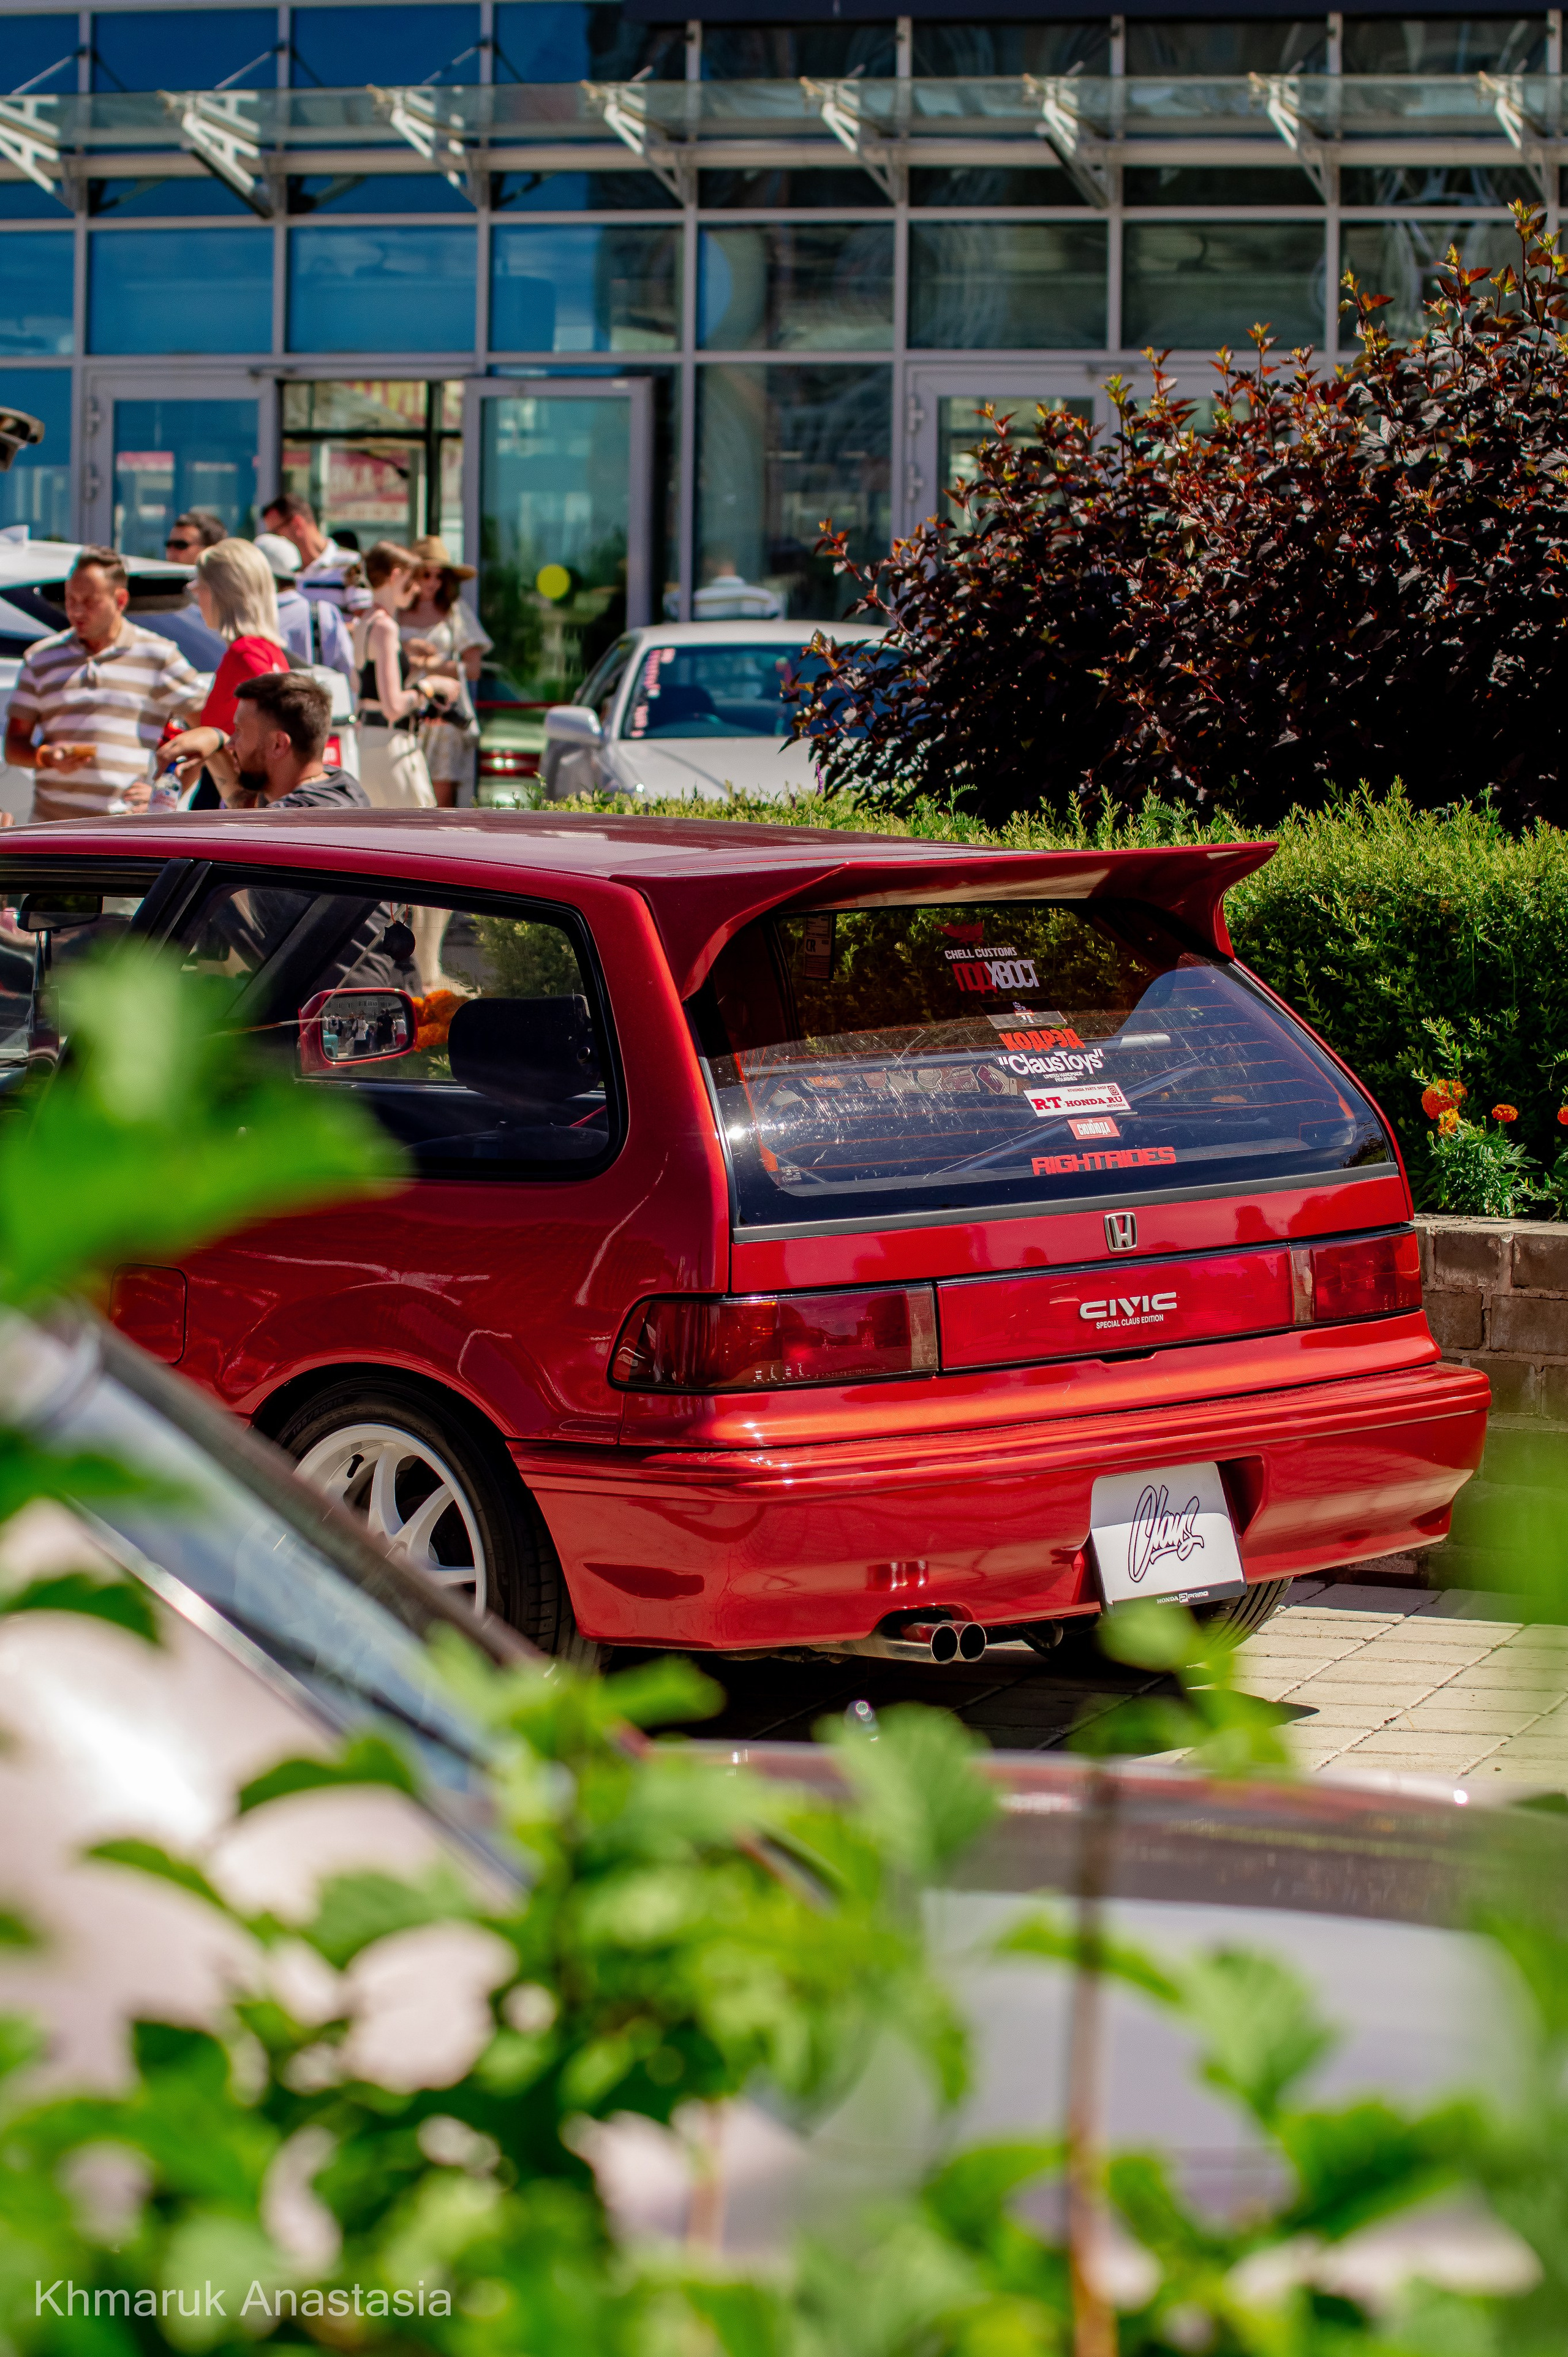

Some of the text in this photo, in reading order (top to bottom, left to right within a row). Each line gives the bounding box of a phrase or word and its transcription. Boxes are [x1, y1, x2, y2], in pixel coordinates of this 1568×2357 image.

[944, 947, 1017, 959] CHELL CUSTOMS
[998, 1028, 1086, 1052] КОДРЭД
[998, 1048, 1103, 1074] "ClausToys"
[1031, 1147, 1176, 1175] RIGHTRIDES
[1079, 1292, 1178, 1320] CIVIC
[1096, 1314, 1164, 1330] SPECIAL CLAUS EDITION
[1188, 1591, 1209, 1599] PRIMO
